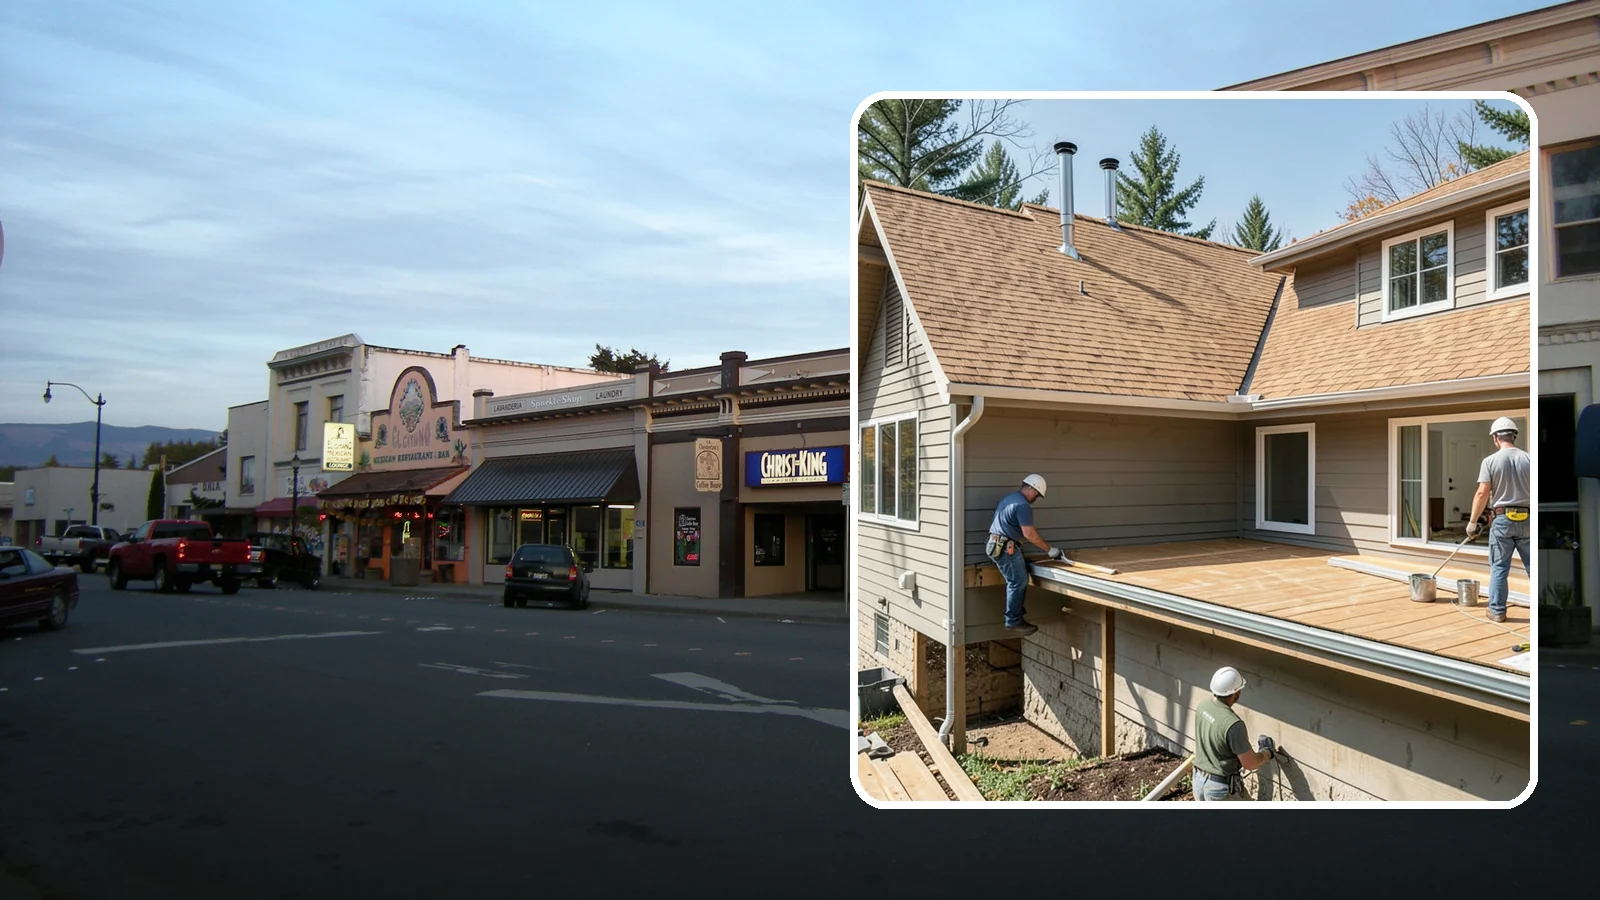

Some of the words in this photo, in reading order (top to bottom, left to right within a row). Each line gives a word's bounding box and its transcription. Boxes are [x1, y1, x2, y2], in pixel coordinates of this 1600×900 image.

[531, 396, 561, 409] Sparkle
[561, 394, 582, 405] Shop
[595, 389, 624, 400] LAUNDRY
[493, 403, 522, 412] LAVANDERIA
[373, 455, 396, 464] MEXICAN
[397, 452, 433, 462] RESTAURANT
[437, 450, 450, 459] BAR
[760, 451, 797, 478] CHRIST
[799, 450, 828, 477] KING
